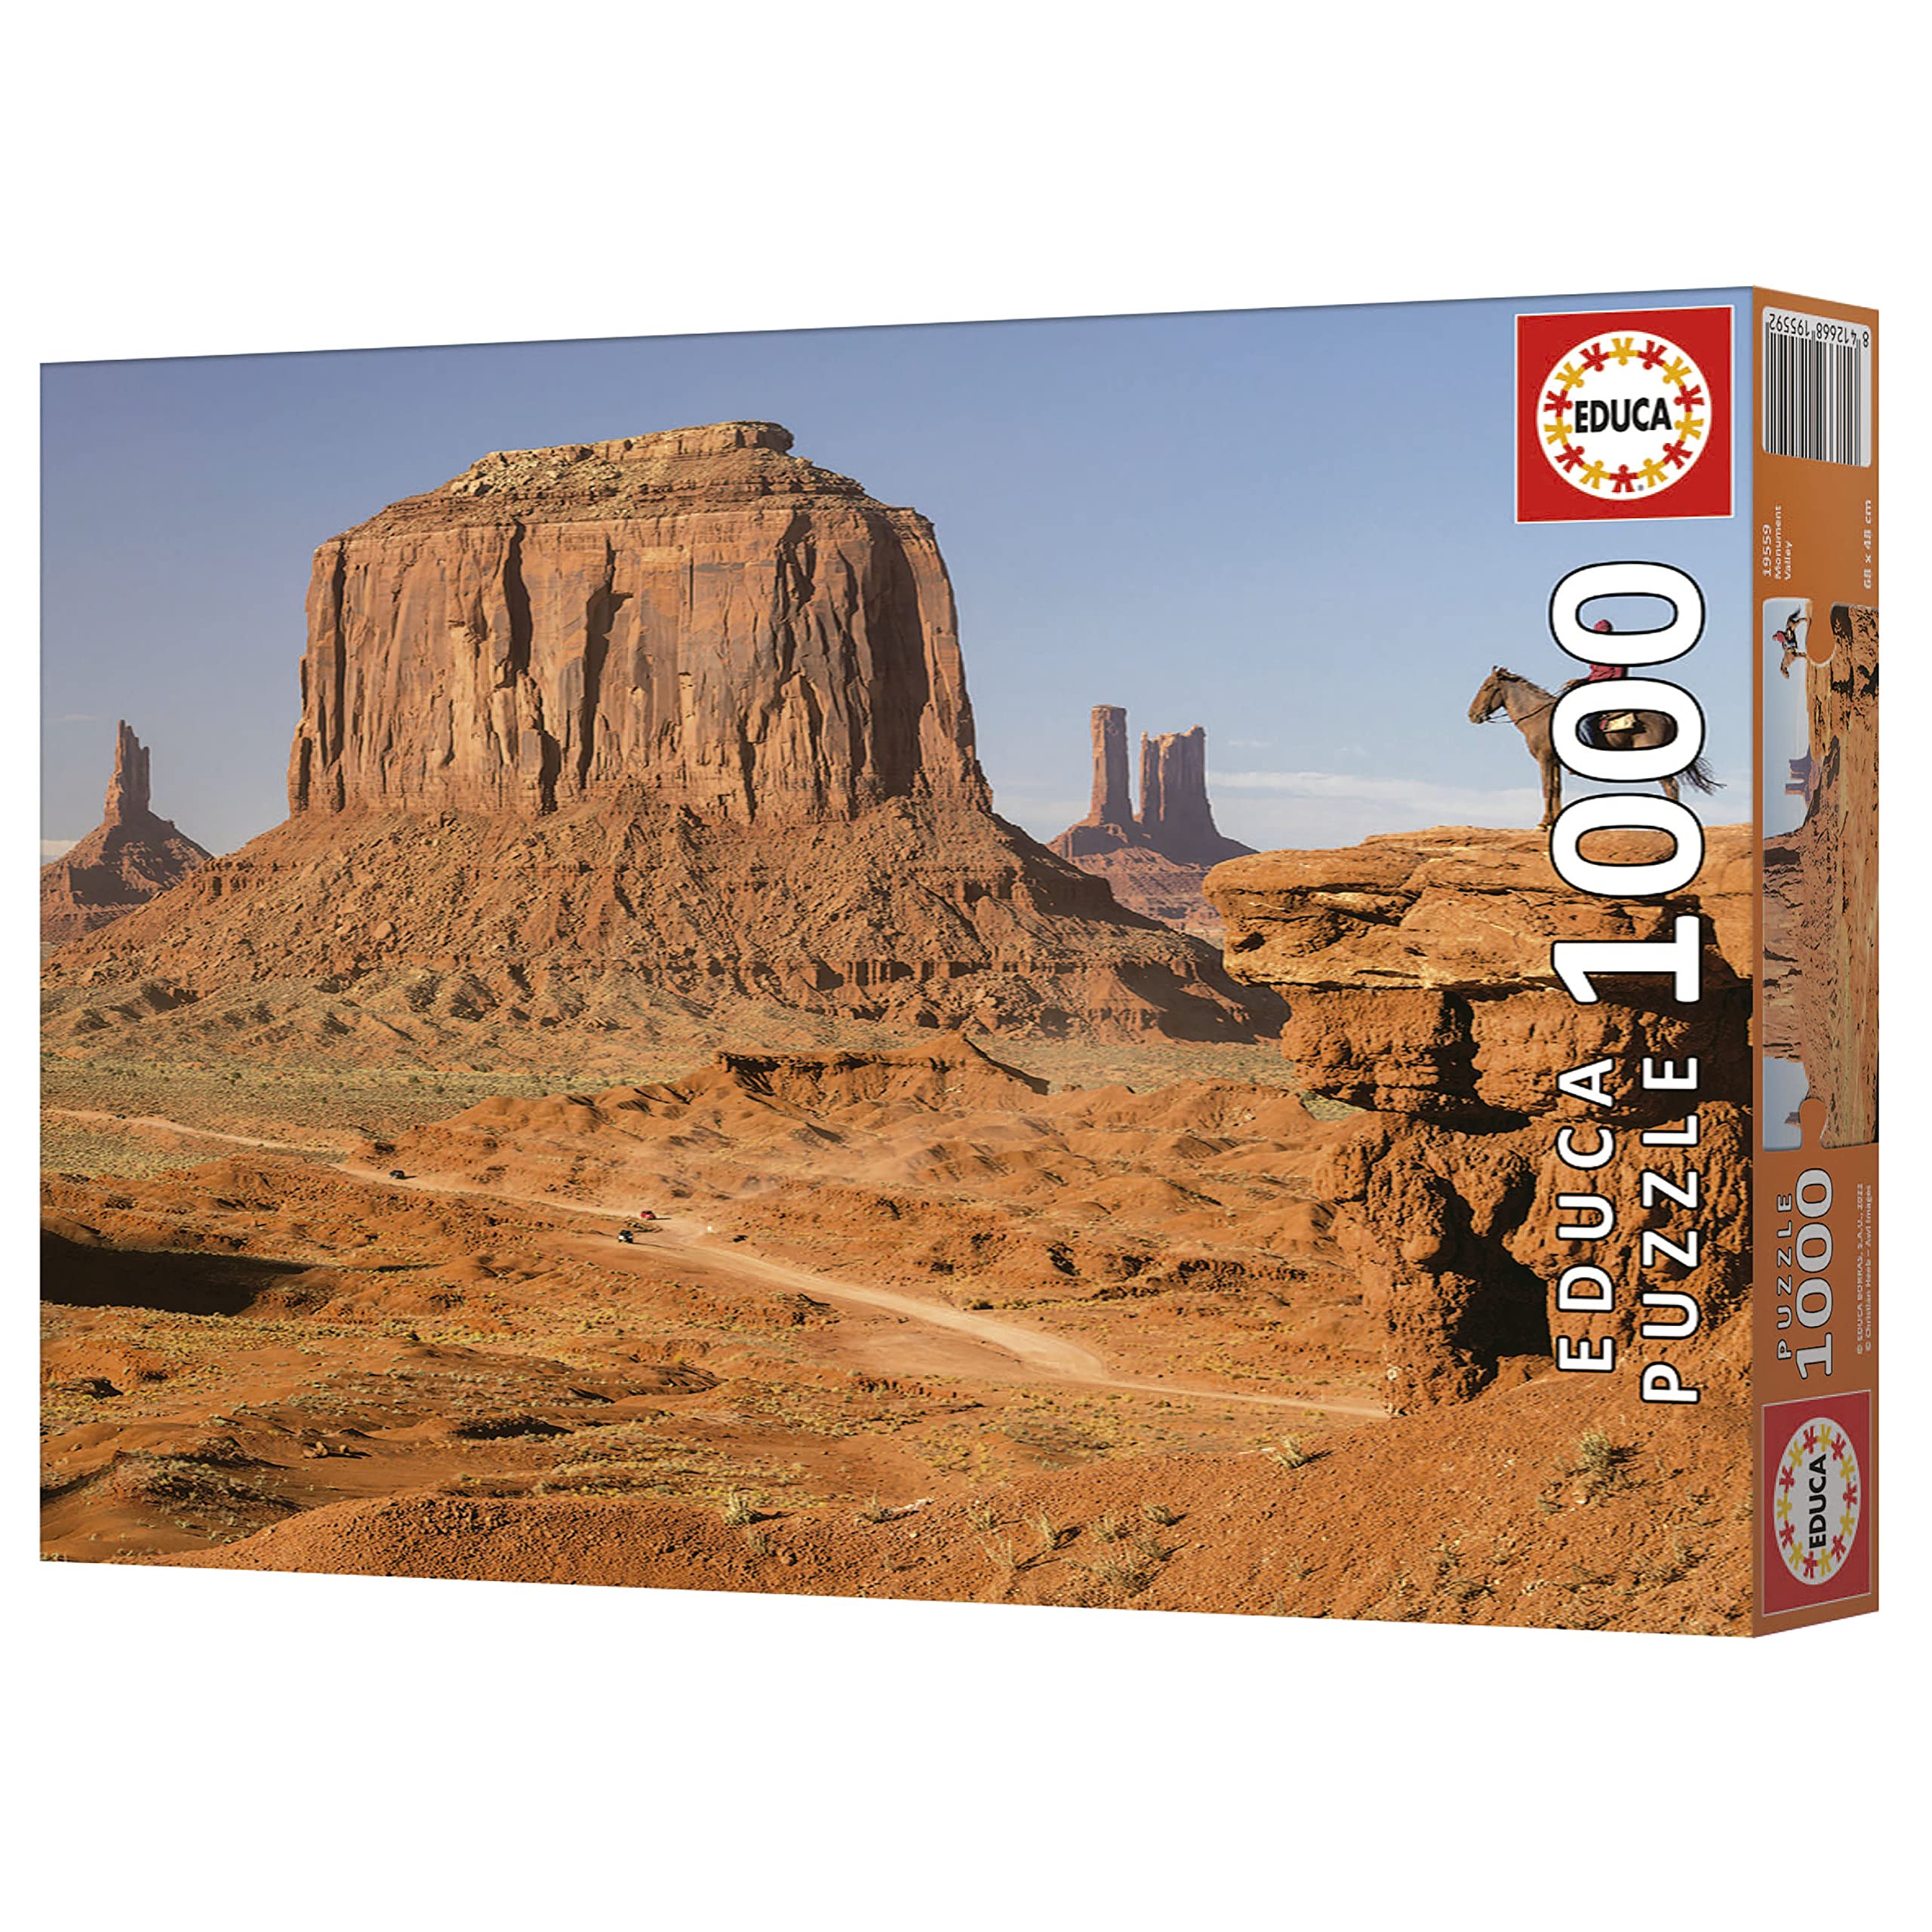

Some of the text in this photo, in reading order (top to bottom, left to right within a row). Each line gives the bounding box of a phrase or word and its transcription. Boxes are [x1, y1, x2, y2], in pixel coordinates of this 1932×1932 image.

[1769, 313, 1869, 348] 8 412668 195592
[1574, 397, 1672, 433] EDUCA
[1762, 524, 1771, 577] 19559
[1784, 541, 1792, 580] Valley
[1863, 500, 1872, 589] 68 x 48 cm
[1549, 561, 1705, 1004] 1000
[1556, 1057, 1615, 1373] EDUCA
[1641, 1056, 1700, 1404] PUZZLE
[1777, 1192, 1792, 1360] PUZZLE
[1795, 1168, 1834, 1380] 1000
[1809, 1454, 1826, 1549] EDUCA
